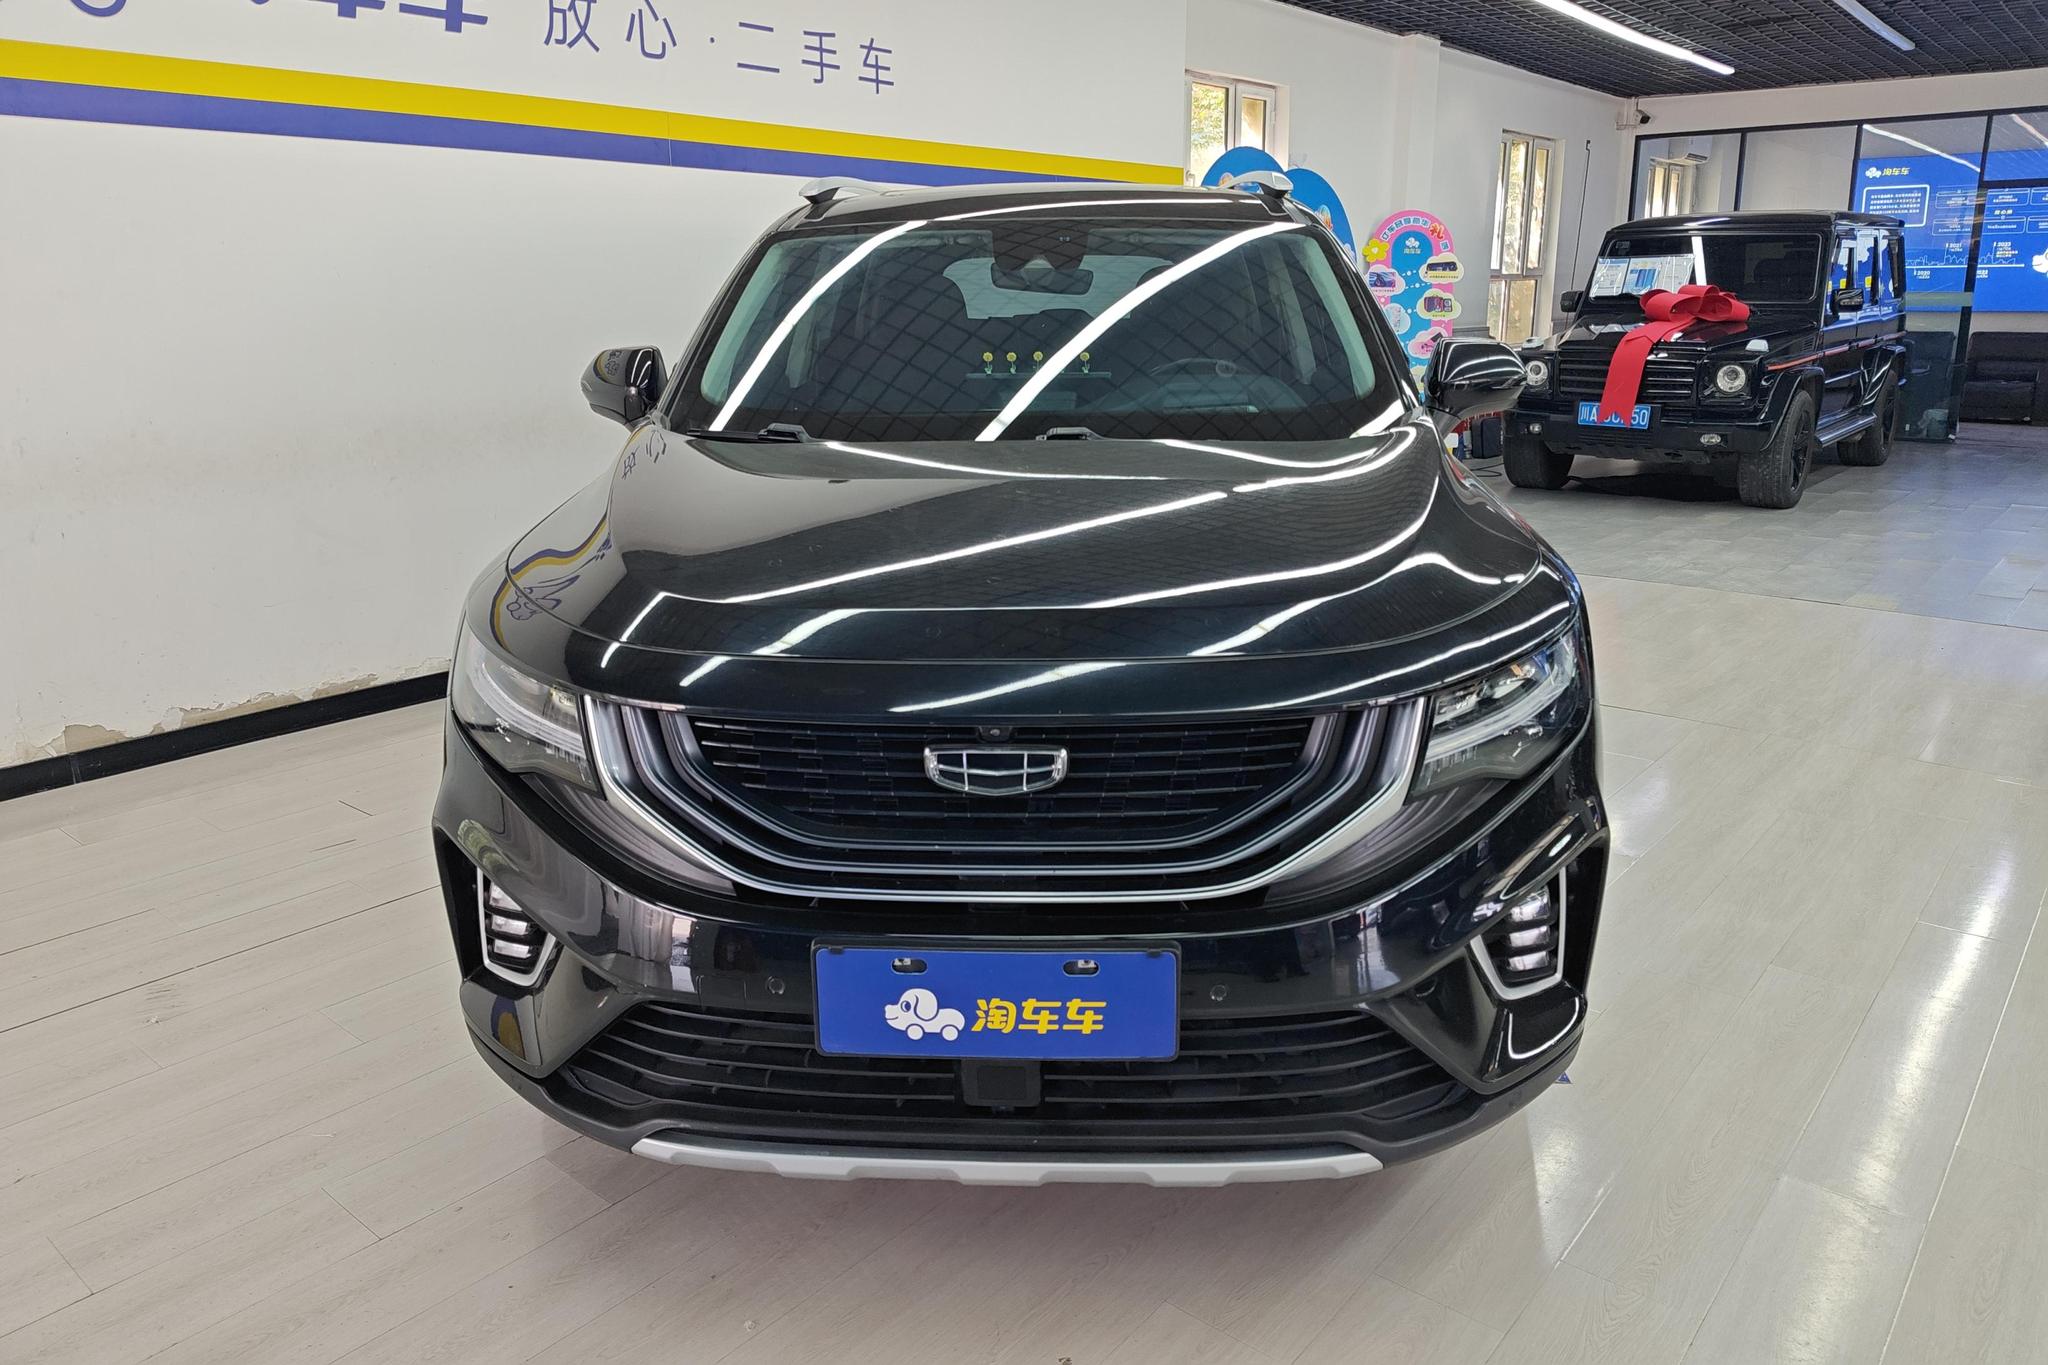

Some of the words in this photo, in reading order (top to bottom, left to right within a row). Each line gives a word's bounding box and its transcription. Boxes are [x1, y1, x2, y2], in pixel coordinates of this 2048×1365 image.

[1581, 405, 1648, 425] 川A50
[971, 998, 1107, 1034] 淘车车
